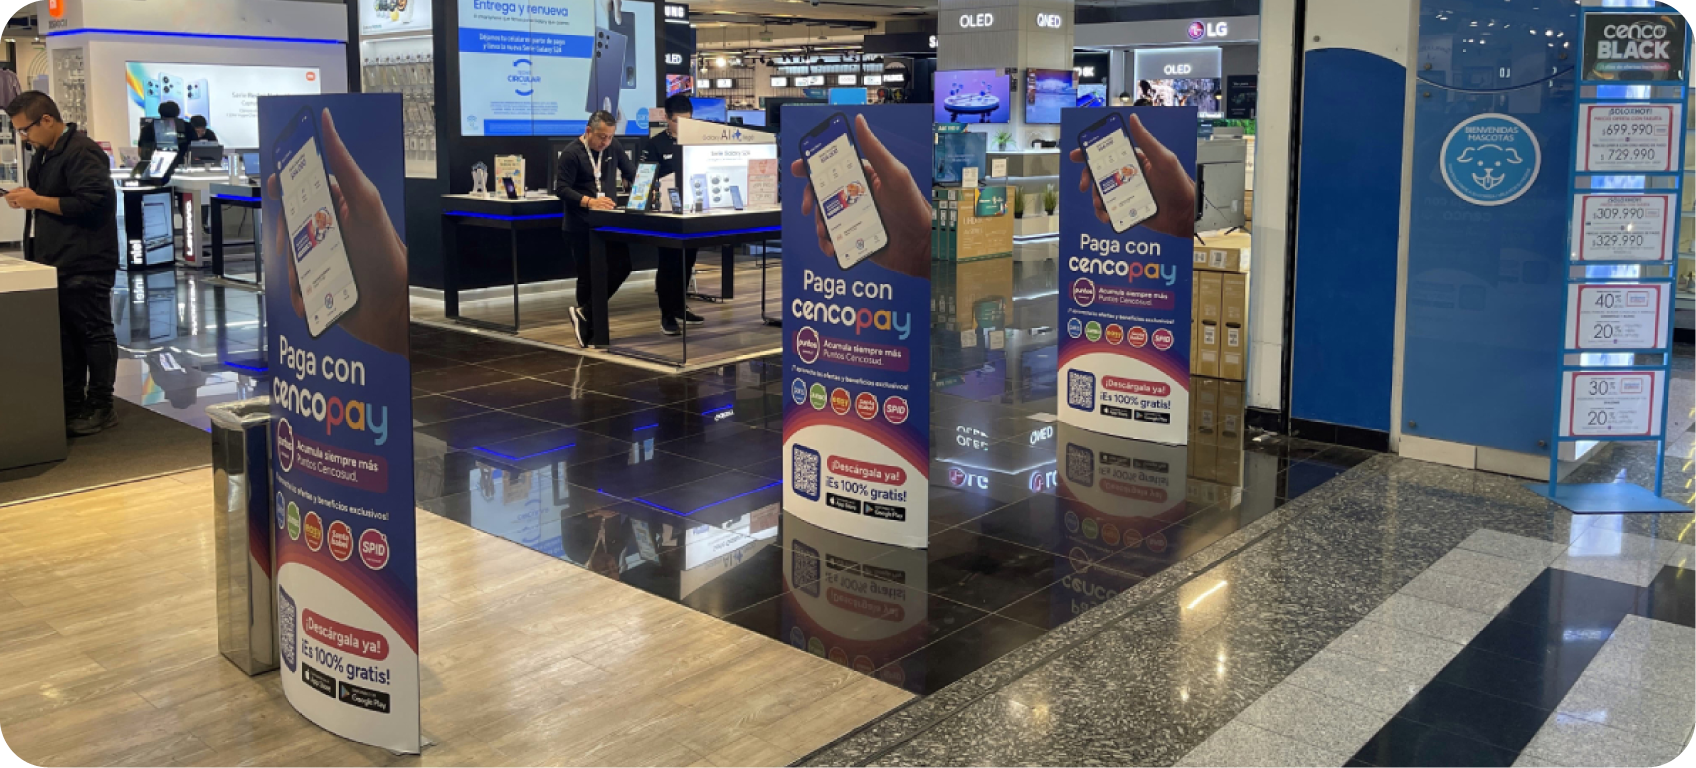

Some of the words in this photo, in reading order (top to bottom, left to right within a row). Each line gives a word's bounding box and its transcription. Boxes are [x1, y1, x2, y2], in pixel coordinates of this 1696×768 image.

[474, 0, 516, 15] Entrega
[518, 4, 525, 17] y
[526, 5, 569, 17] renueva
[960, 13, 993, 28] OLED
[1037, 13, 1061, 28] QNED
[1206, 21, 1227, 37] LG
[1604, 25, 1667, 39] cenco
[1597, 40, 1670, 59] BLACK
[1164, 64, 1191, 75] OLED
[507, 75, 541, 83] CIRCULAR
[721, 129, 731, 140] AI
[1465, 126, 1519, 134] BIENVENIDAS
[1468, 134, 1514, 142] MASCOTAS
[1080, 233, 1120, 256] Paga
[1125, 241, 1160, 256] con
[1068, 256, 1177, 286] cencopay
[803, 269, 846, 299] Paga
[852, 280, 893, 300] con
[1099, 294, 1118, 303] Puntos
[1126, 291, 1152, 299] siempre
[792, 298, 912, 340] cencopay
[823, 339, 852, 352] Acumula
[853, 345, 883, 356] siempre
[885, 349, 902, 358] más
[823, 349, 844, 360] Puntos
[279, 334, 317, 381] Paga
[321, 355, 365, 386] con
[1105, 380, 1150, 393] ¡Descárgala
[1152, 386, 1166, 394] ya!
[886, 404, 905, 414] SPID
[1100, 392, 1112, 401] ¡Es
[1114, 394, 1139, 406] 100%
[1140, 399, 1171, 410] gratis!
[273, 376, 388, 446] cencopay
[296, 439, 324, 459] Acumula
[324, 450, 357, 468] siempre
[358, 458, 379, 472] más
[296, 453, 317, 470] Puntos
[317, 461, 358, 482] Cencosud.
[831, 460, 881, 479] ¡Descárgala
[884, 471, 900, 482] ya!
[826, 476, 839, 488] ¡Es
[840, 479, 868, 496] 100%
[870, 488, 907, 502] gratis!
[317, 496, 348, 512] beneficios
[349, 506, 389, 521] exclusivos!
[362, 541, 385, 556] SPID
[305, 617, 359, 648] ¡Descárgala
[362, 639, 381, 654] ya!
[302, 638, 313, 659] ¡Es
[315, 646, 344, 673] 100%
[346, 663, 390, 685] gratis!
[351, 693, 372, 707] Google
